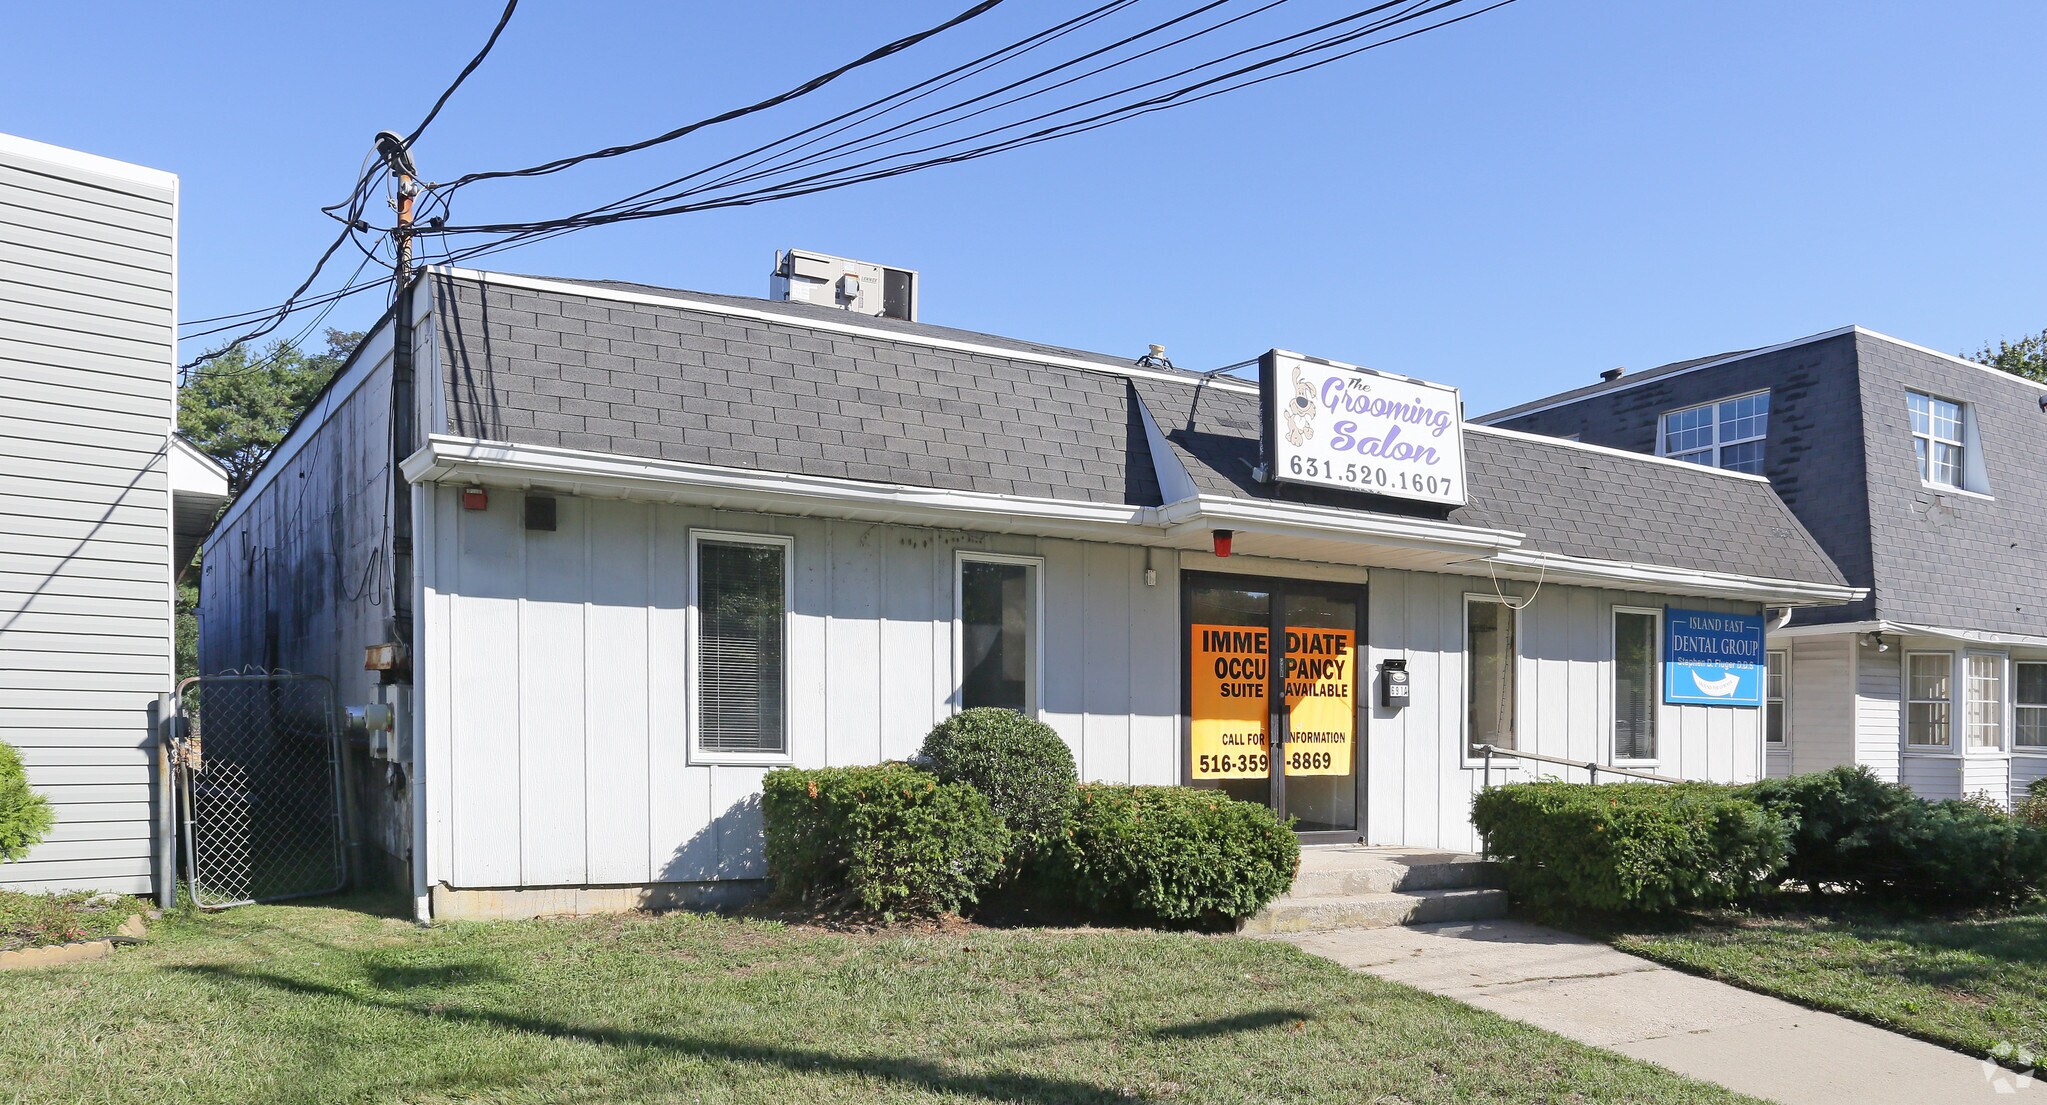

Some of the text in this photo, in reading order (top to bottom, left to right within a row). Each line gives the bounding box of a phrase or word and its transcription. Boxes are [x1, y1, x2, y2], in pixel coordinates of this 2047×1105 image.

[1348, 377, 1371, 393] The
[1321, 376, 1452, 438] Grooming
[1330, 420, 1440, 465] Salon
[1290, 455, 1451, 496] 631.520.1607
[1689, 616, 1744, 633] ISLAND EAST
[1674, 634, 1758, 656] DENTAL GROUP
[1220, 683, 1348, 698] SUITE AVAILABLE
[1222, 731, 1346, 746] CALL FOR NFORMATION
